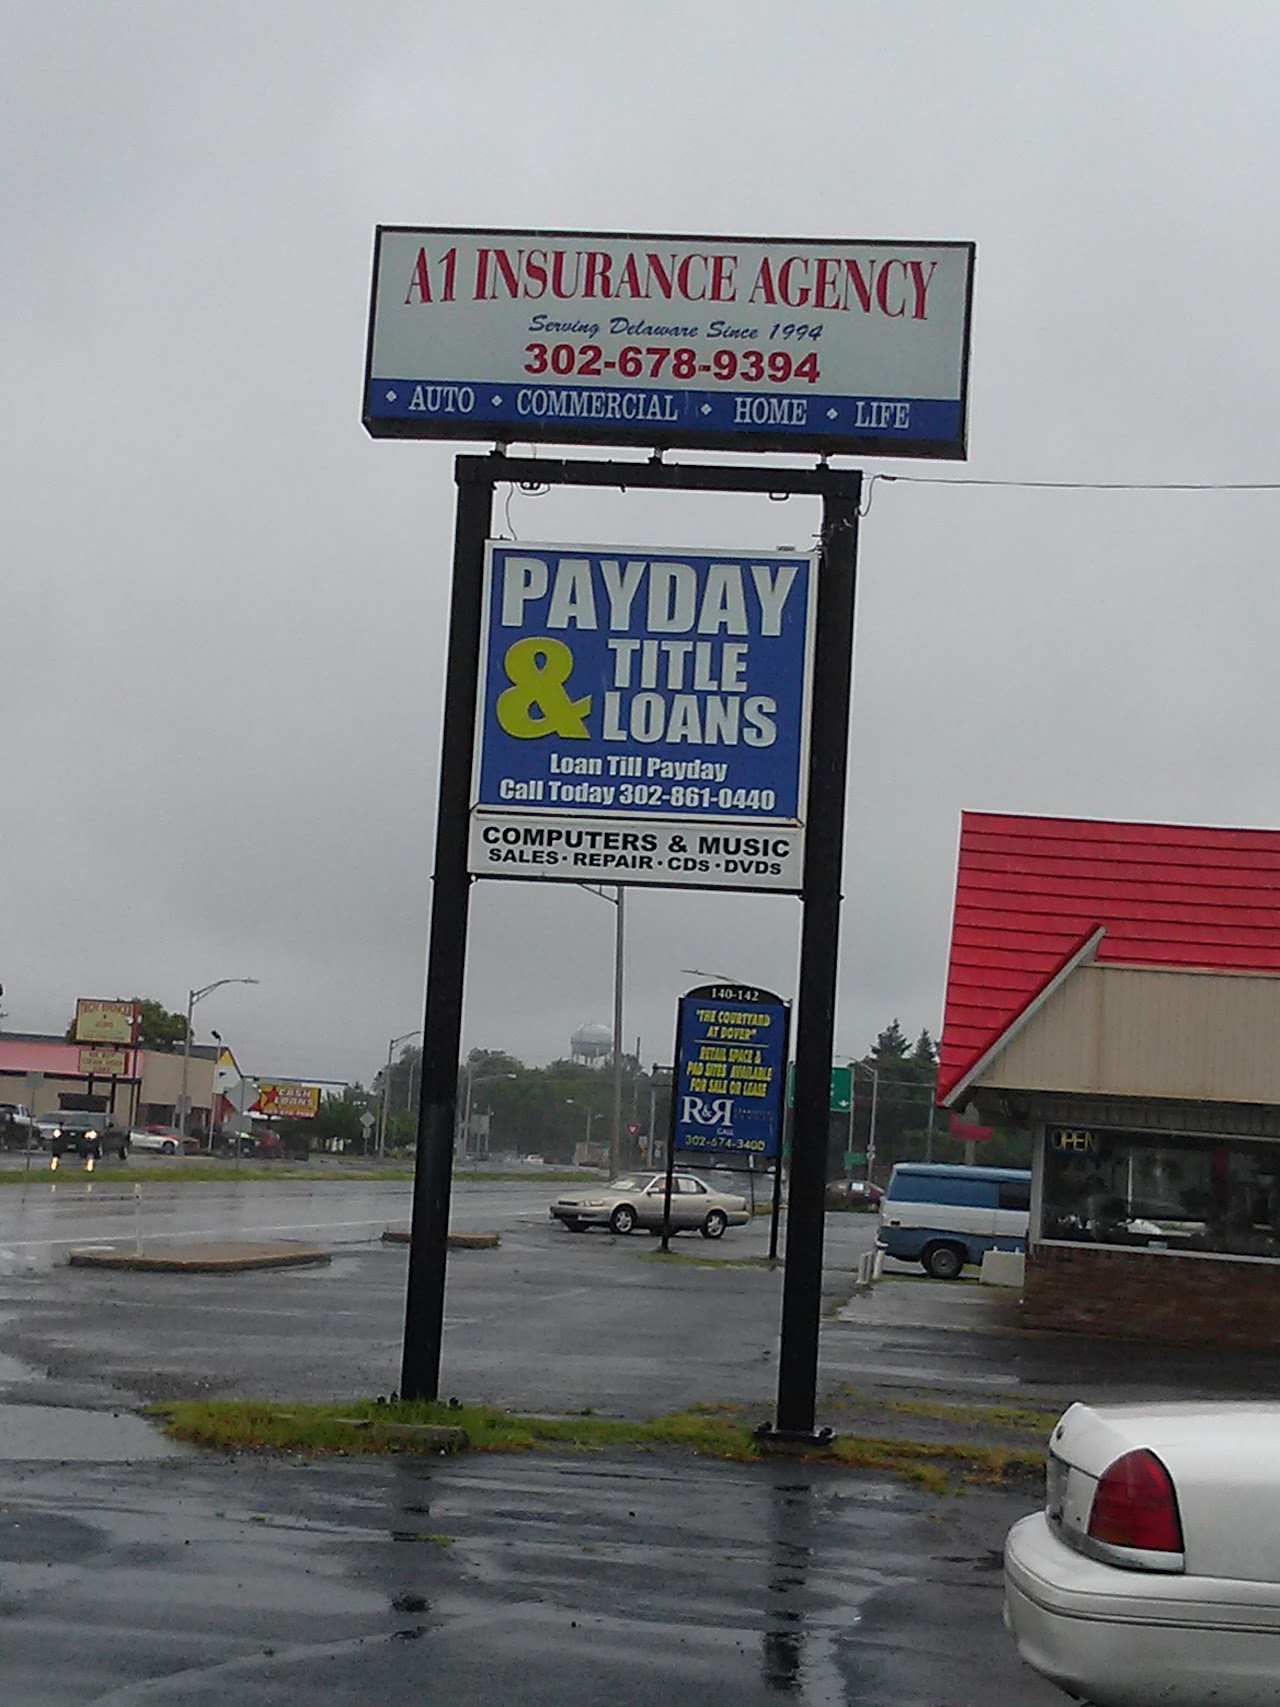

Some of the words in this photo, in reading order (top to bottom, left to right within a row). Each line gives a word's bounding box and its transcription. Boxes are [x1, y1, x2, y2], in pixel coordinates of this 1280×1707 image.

[404, 246, 459, 305] A1
[472, 247, 738, 303] INSURANCE
[747, 255, 939, 320] AGENCY
[528, 314, 602, 339] Serving
[609, 318, 700, 339] Delaware
[706, 320, 760, 340] Since
[768, 323, 825, 342] 1994
[523, 343, 821, 384] 302-678-9394
[408, 386, 476, 415] AUTO
[516, 389, 679, 422] COMMERCIAL
[733, 397, 808, 427] HOME
[853, 401, 911, 430] LIFE
[501, 556, 799, 637] PAYDAY
[607, 638, 749, 693] TITLE
[496, 636, 592, 739] &
[602, 691, 778, 748] LOANS
[550, 753, 602, 776] Loan
[607, 755, 642, 777] Till
[649, 757, 728, 783] Payday
[499, 778, 544, 801] Call
[548, 781, 616, 805] Today
[619, 784, 776, 811] 302-861-0440
[482, 826, 658, 852] COMPUTERS
[668, 835, 688, 853] &
[699, 836, 791, 859] MUSIC
[711, 988, 760, 1002] 140-142
[706, 1025, 720, 1037] AT
[718, 1010, 771, 1027] COURTYARD
[728, 1048, 753, 1063] SPACE
[690, 1077, 708, 1092] FOR
[708, 1079, 728, 1094] SALE
[729, 1080, 742, 1095] OR
[743, 1082, 767, 1097] LEASE
[705, 1063, 727, 1078] SITES
[730, 1065, 773, 1082] AVAILABLE
[1052, 1130, 1096, 1152] OPEN
